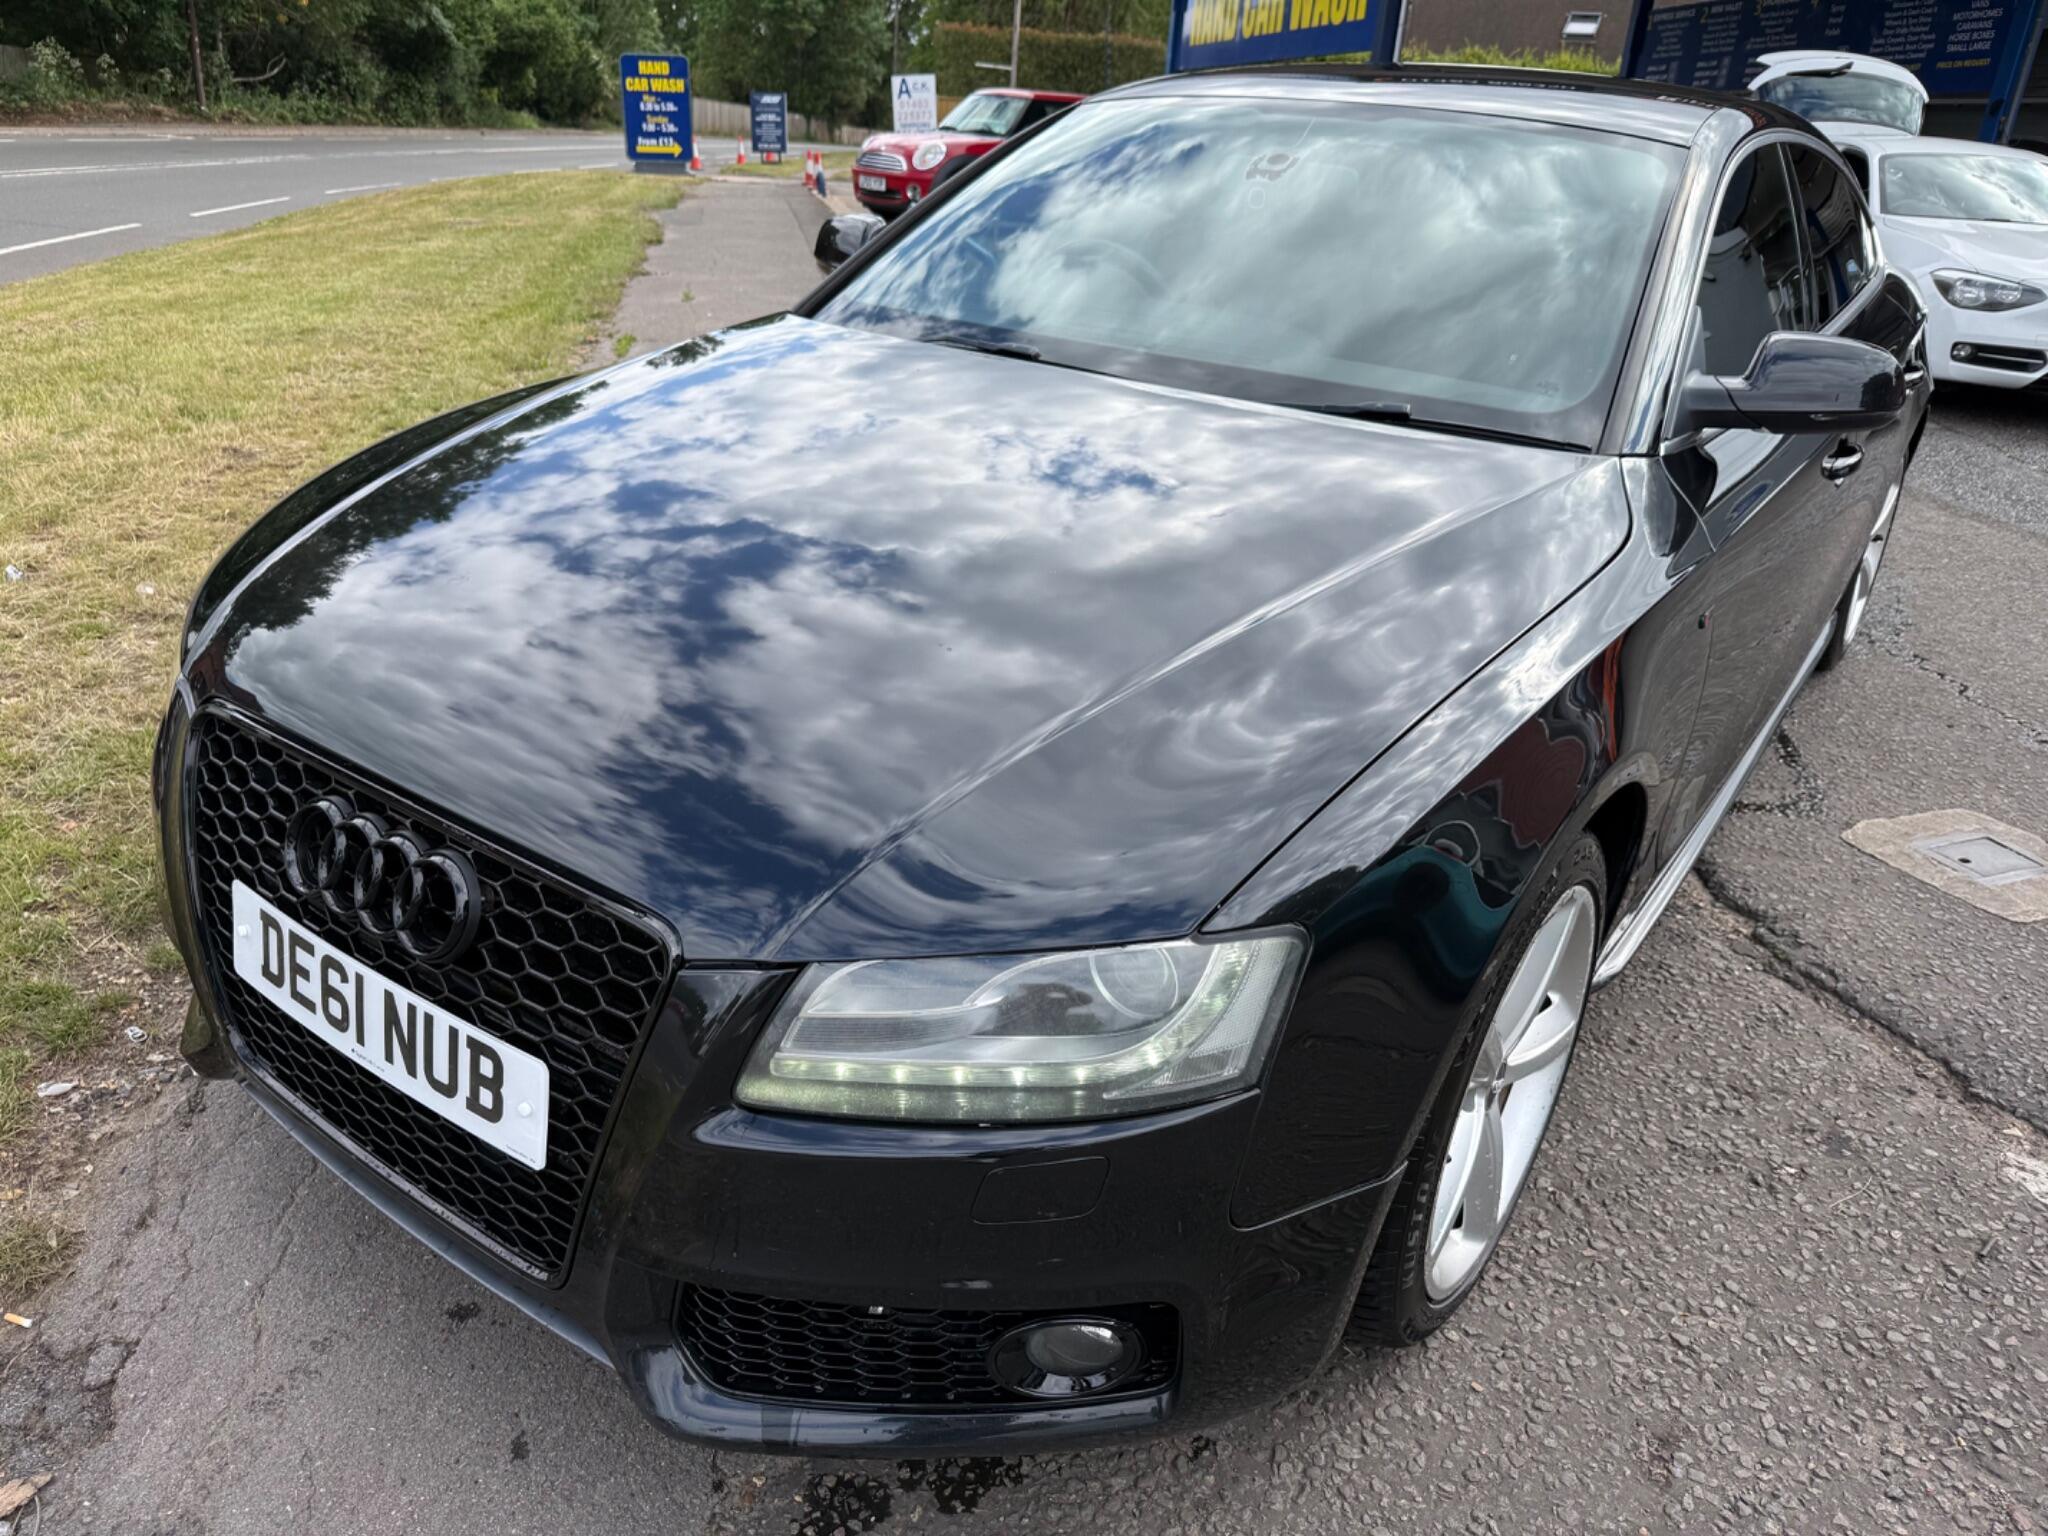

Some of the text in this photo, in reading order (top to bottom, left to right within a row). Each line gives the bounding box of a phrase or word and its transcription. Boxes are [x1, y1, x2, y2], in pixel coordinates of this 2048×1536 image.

[638, 60, 670, 75] HAND
[625, 77, 685, 93] CAR WASH
[898, 78, 911, 99] A
[260, 908, 504, 1124] DE61 NUB
